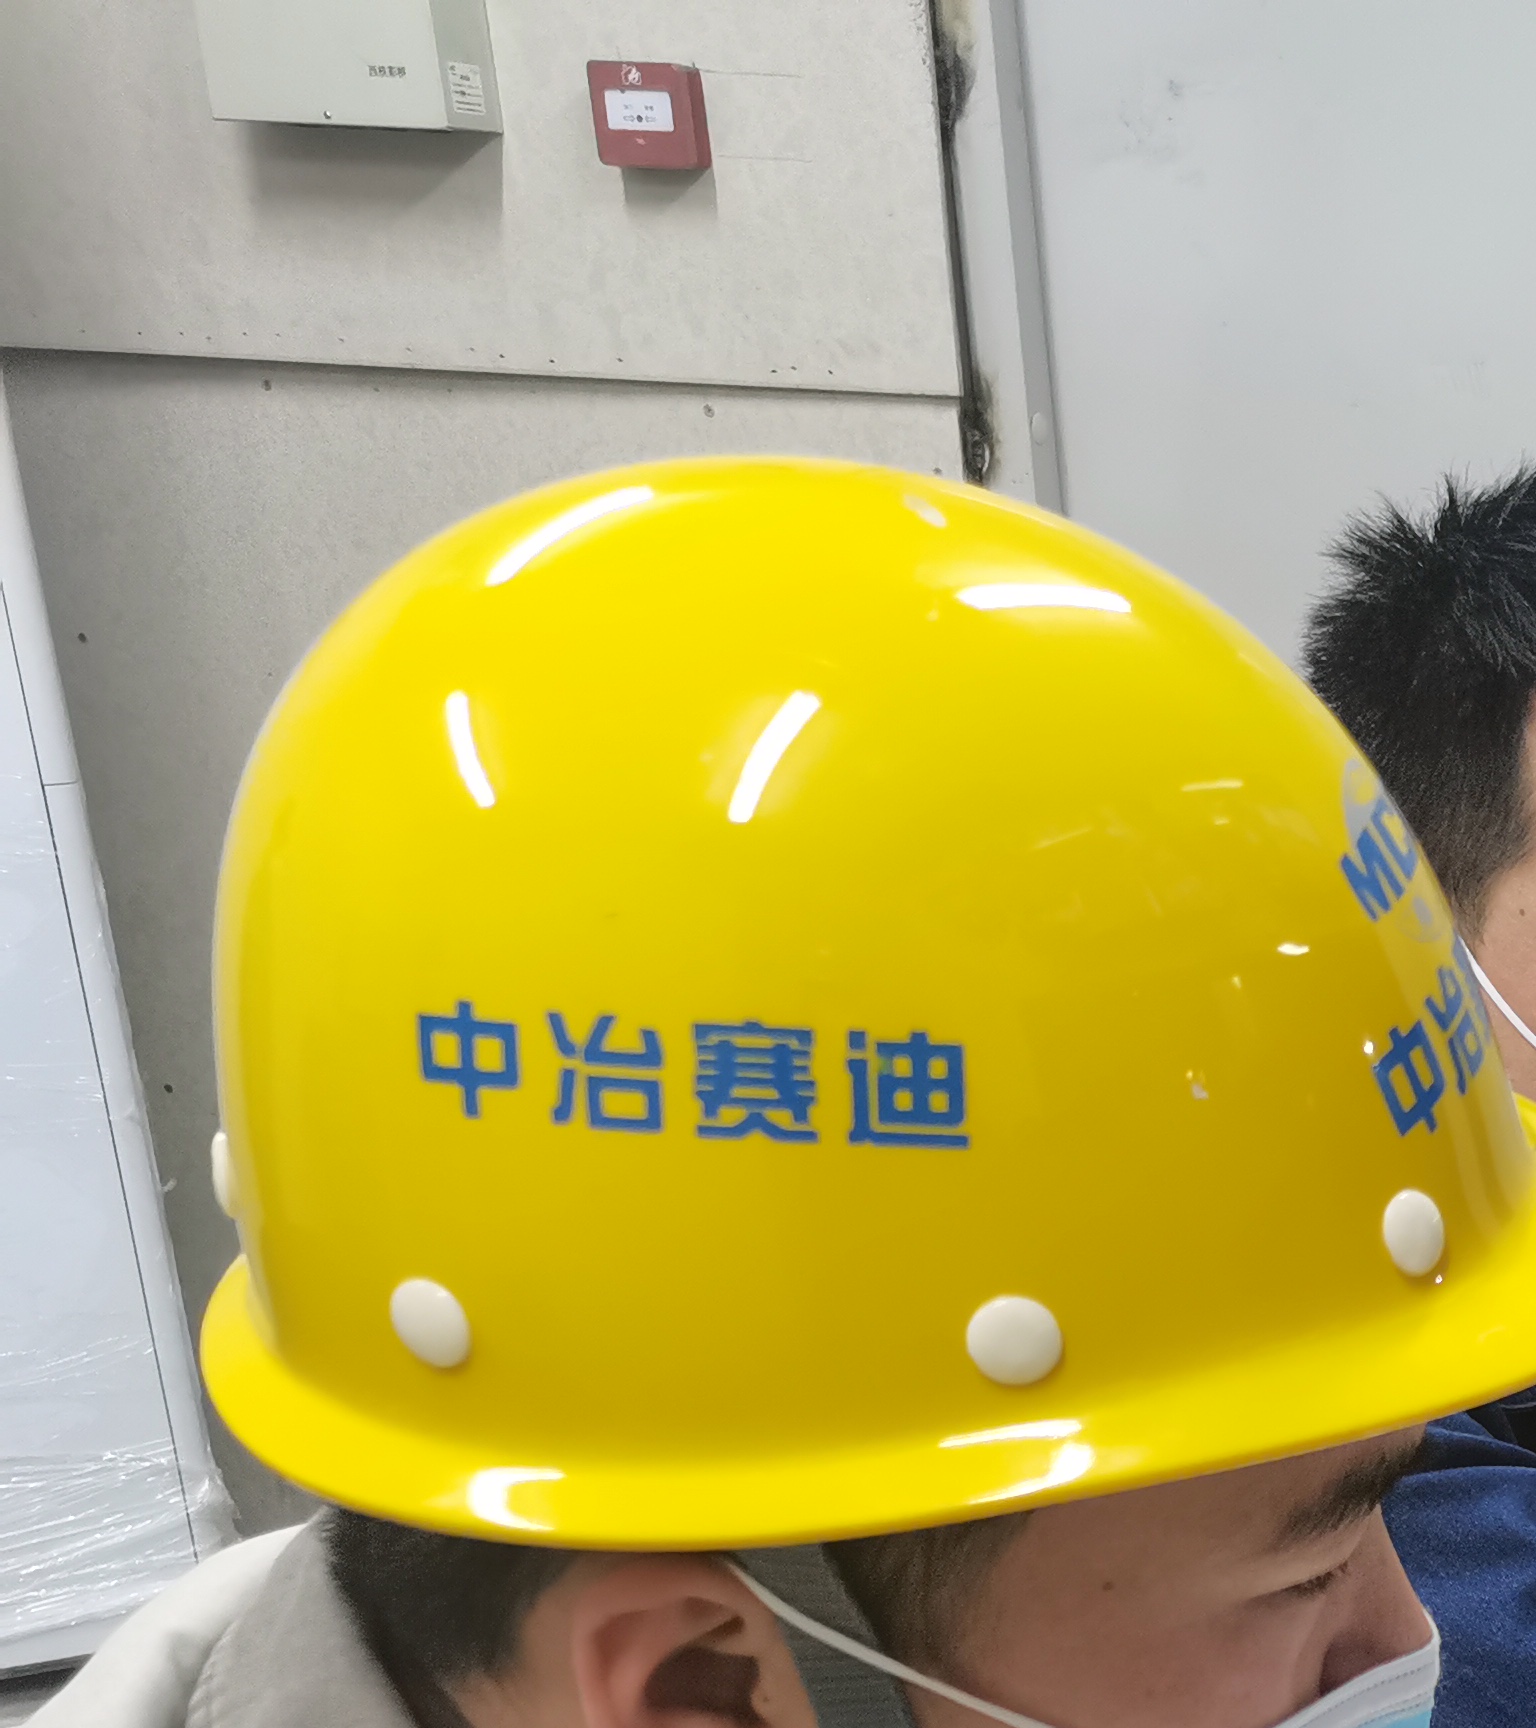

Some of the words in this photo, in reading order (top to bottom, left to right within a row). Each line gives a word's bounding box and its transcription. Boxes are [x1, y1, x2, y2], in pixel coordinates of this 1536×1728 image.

[416, 998, 971, 1149] 中冶赛迪
[1371, 928, 1493, 1137] 中冶
